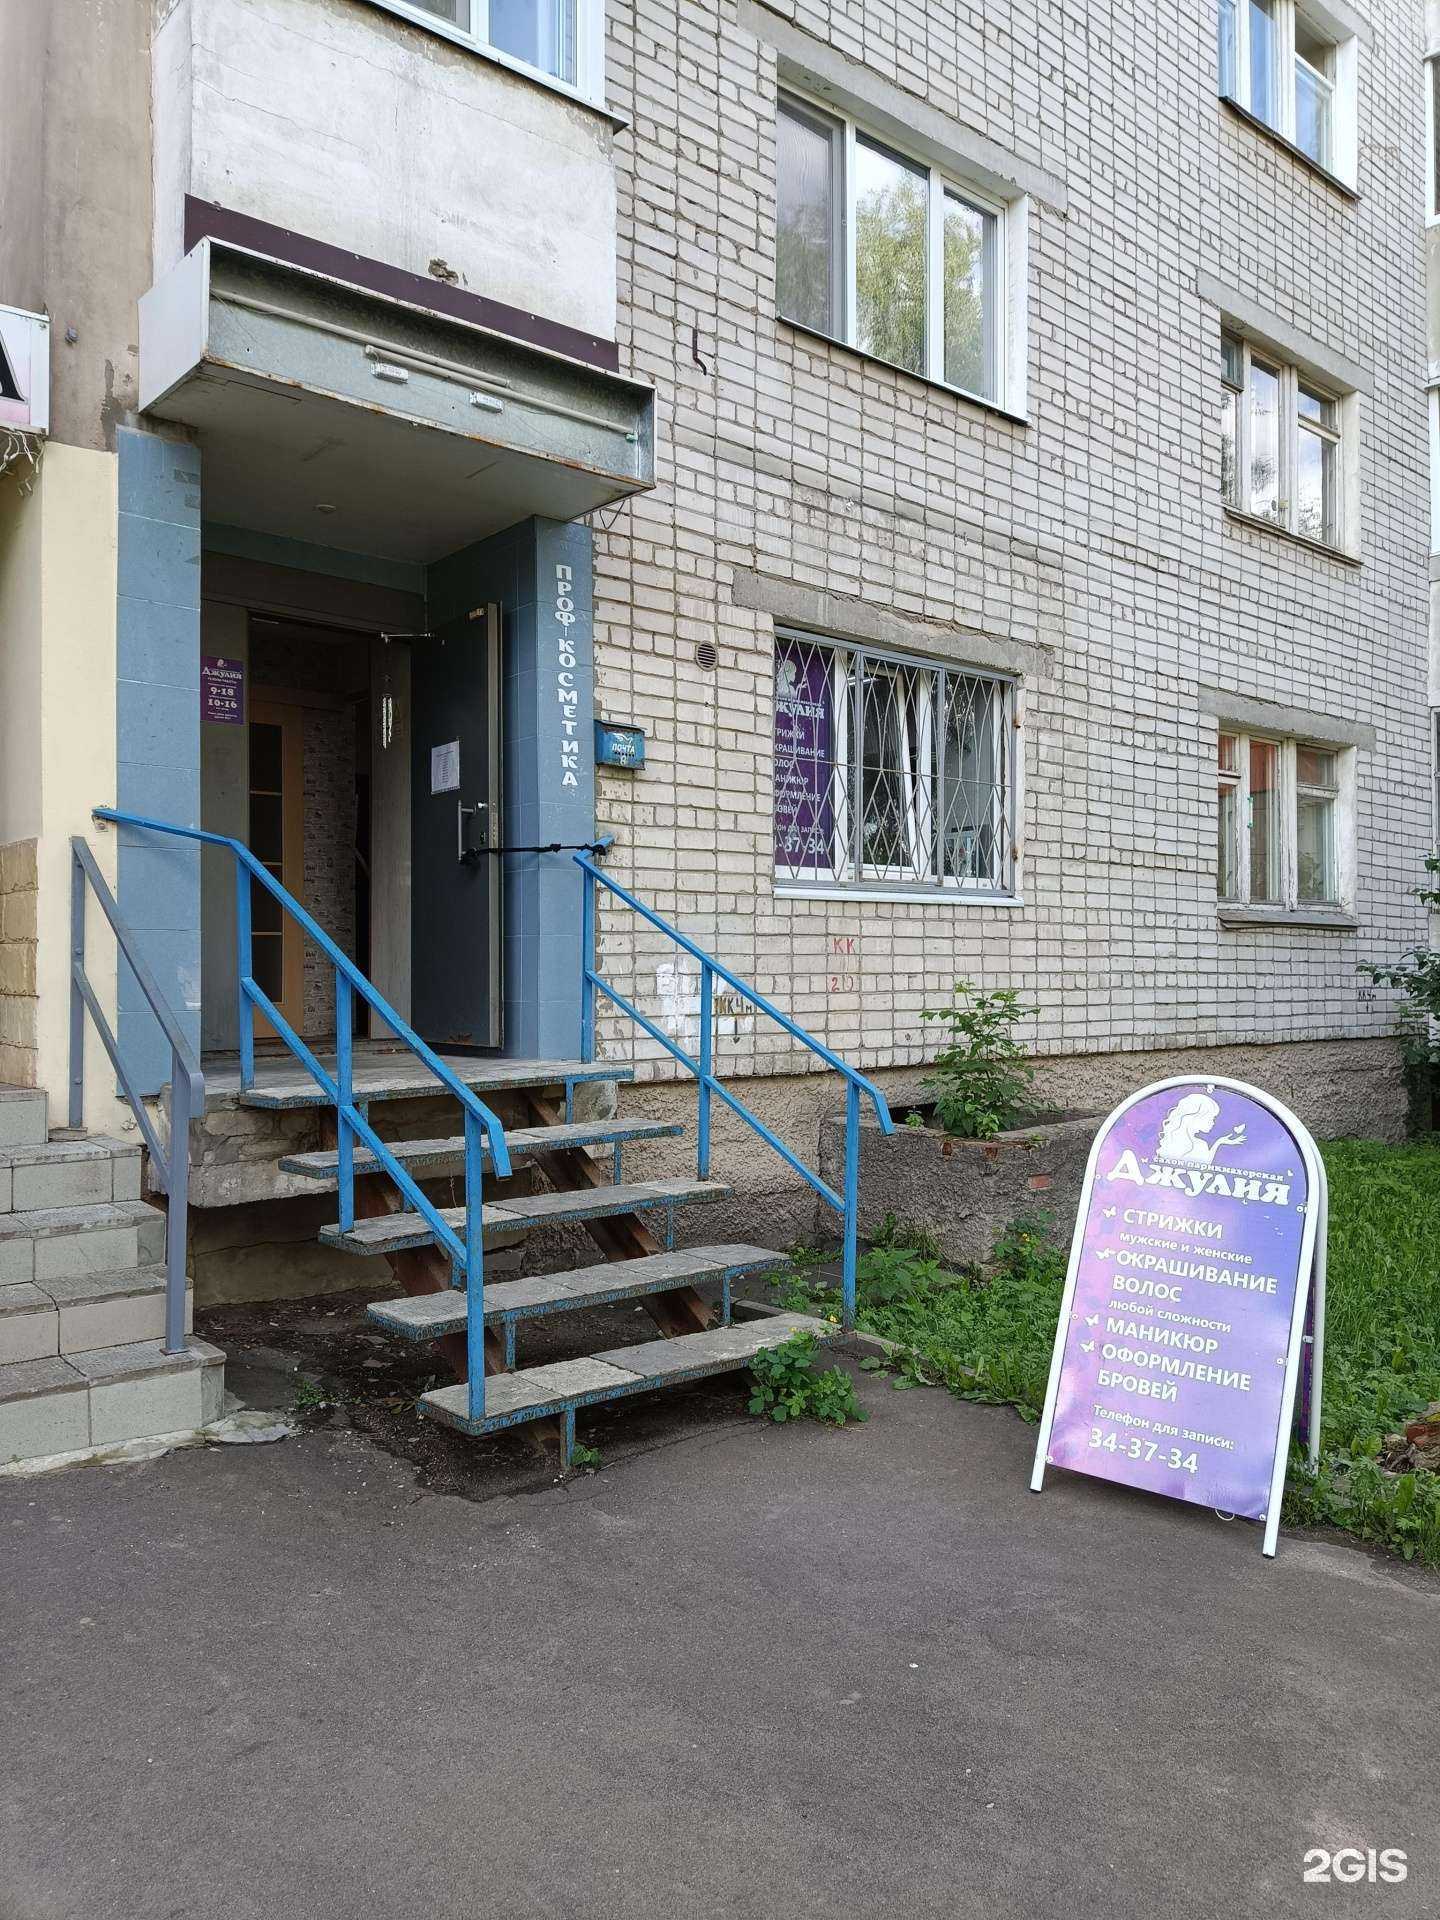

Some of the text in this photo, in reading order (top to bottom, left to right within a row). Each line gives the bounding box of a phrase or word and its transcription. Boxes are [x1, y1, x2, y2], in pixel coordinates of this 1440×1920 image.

[612, 743, 635, 753] ПОЧТА
[1106, 1149, 1291, 1205] Джулия
[1123, 1208, 1223, 1239] СТРИЖКИ
[1119, 1232, 1253, 1265] мужские и женские
[1112, 1274, 1183, 1303] ВОЛОС
[1116, 1249, 1278, 1295] ОКРАШИВАНИЕ
[1108, 1298, 1232, 1334] любой сложности
[1106, 1317, 1218, 1355] МАНИКЮР
[1098, 1368, 1178, 1403] БРОВЕЙ
[1102, 1343, 1252, 1392] ОФОРМЛЕНИЕ
[1093, 1403, 1235, 1450] Телефон для записи:
[1088, 1427, 1199, 1474] 34-37-34
